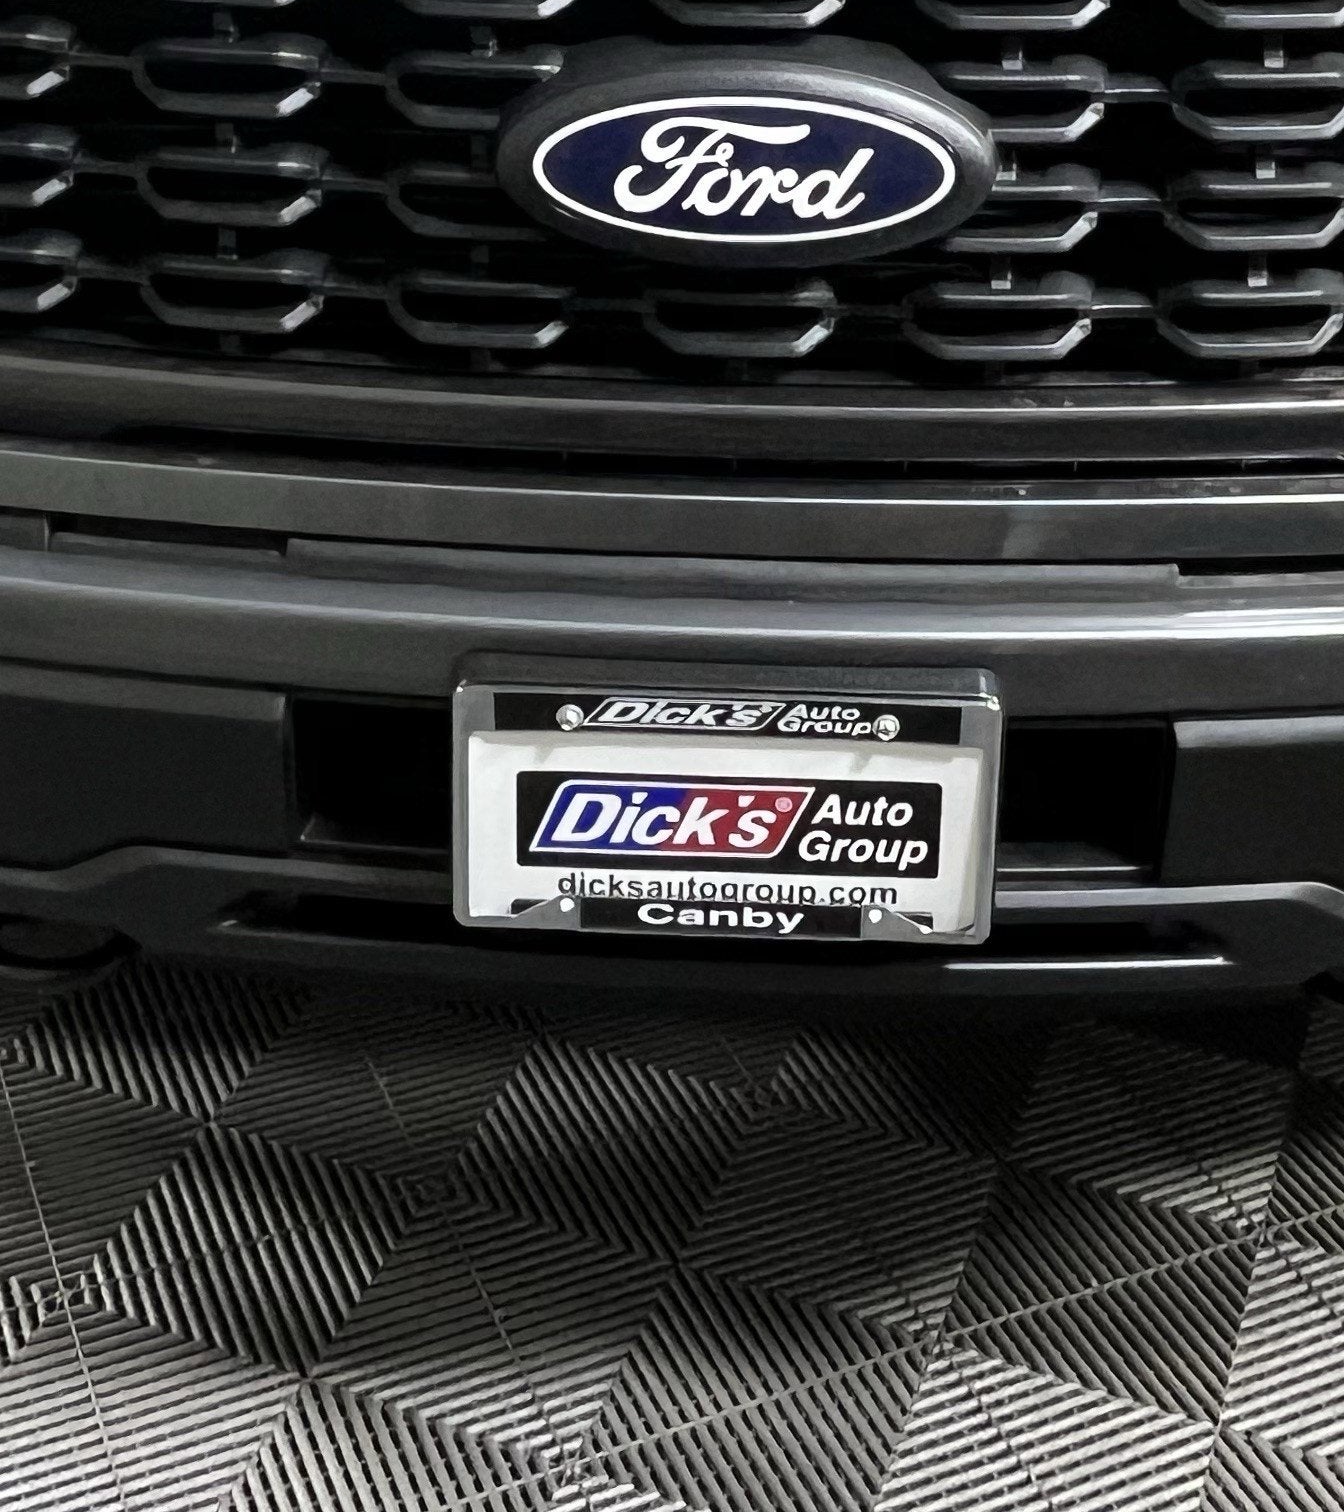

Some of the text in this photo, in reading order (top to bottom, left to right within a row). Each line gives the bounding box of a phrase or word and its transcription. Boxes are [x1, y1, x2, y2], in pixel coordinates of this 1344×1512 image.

[613, 116, 875, 220] Ford
[777, 717, 872, 735] Group
[787, 704, 861, 720] Auto
[550, 791, 777, 848] Dick's
[811, 793, 914, 827] Auto
[798, 833, 929, 872] Group
[557, 872, 898, 906] dicksautogroup.com
[637, 903, 805, 934] Canby
